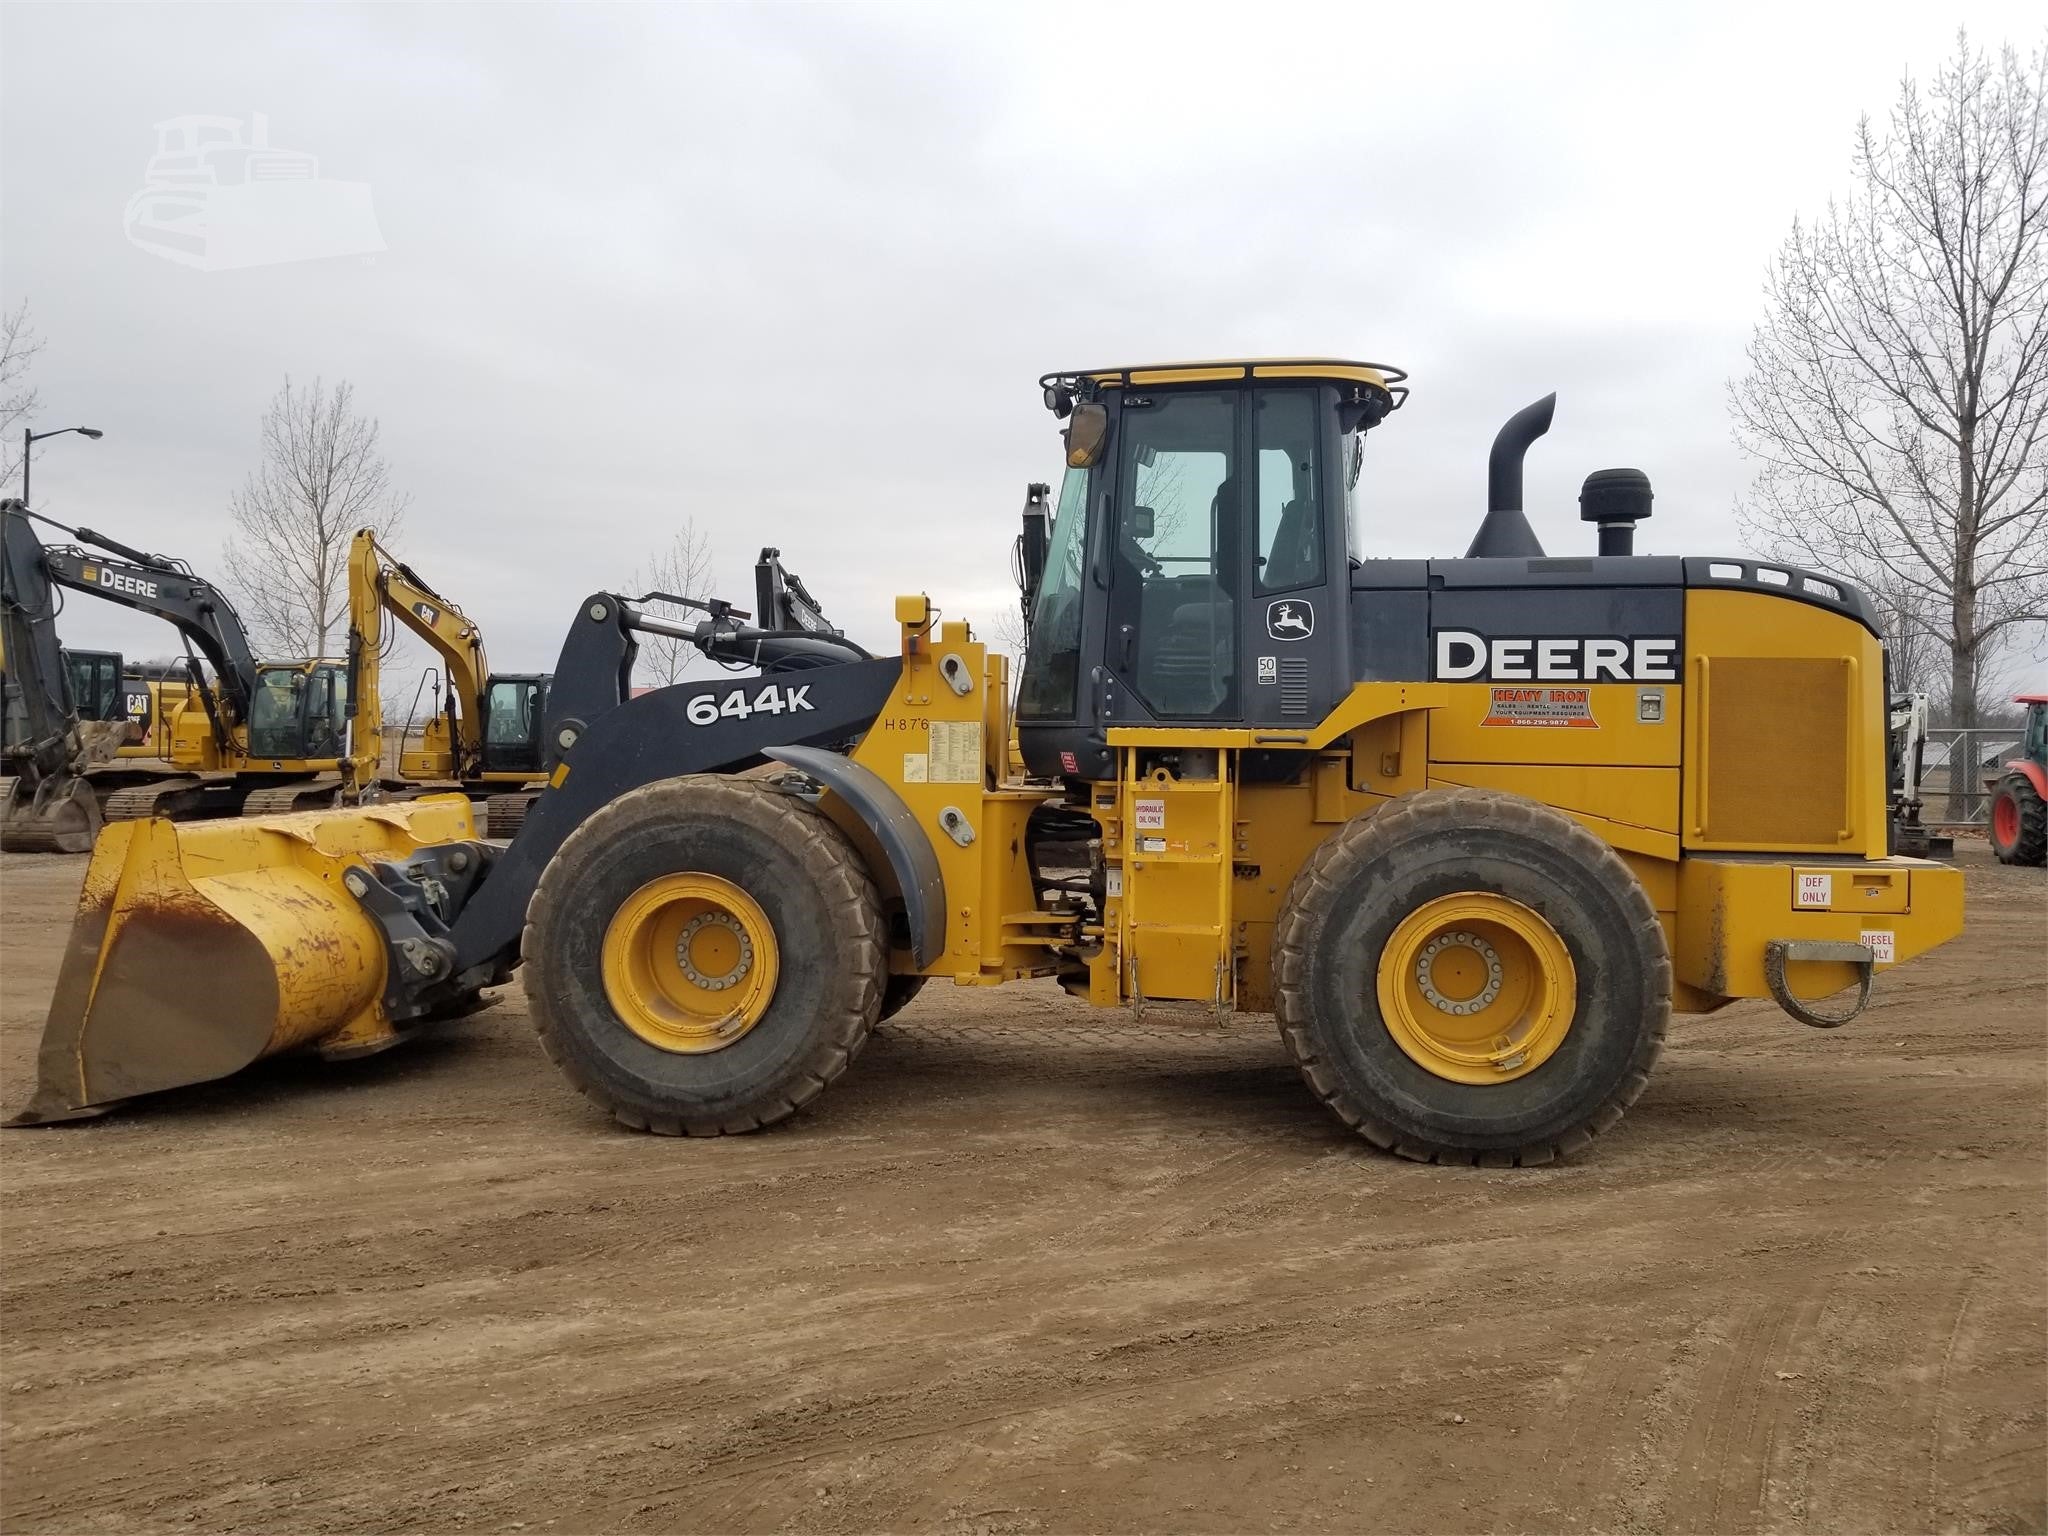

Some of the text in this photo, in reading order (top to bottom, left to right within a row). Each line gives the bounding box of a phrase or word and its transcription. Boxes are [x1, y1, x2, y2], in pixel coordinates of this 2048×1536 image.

[101, 567, 158, 599] DEERE
[801, 609, 817, 632] DEERE
[1436, 631, 1676, 680] DEERE
[1259, 658, 1275, 671] 50
[1493, 689, 1587, 703] HEAVY IRON
[126, 694, 149, 714] CAT
[686, 684, 816, 726] 644K
[1136, 805, 1164, 813] HYDRAULIC
[1138, 815, 1161, 825] OIL ONLY
[1805, 877, 1824, 888] DEF
[1802, 892, 1827, 903] ONLY
[1861, 935, 1893, 945] DIESEL
[1873, 949, 1889, 959] NLY
